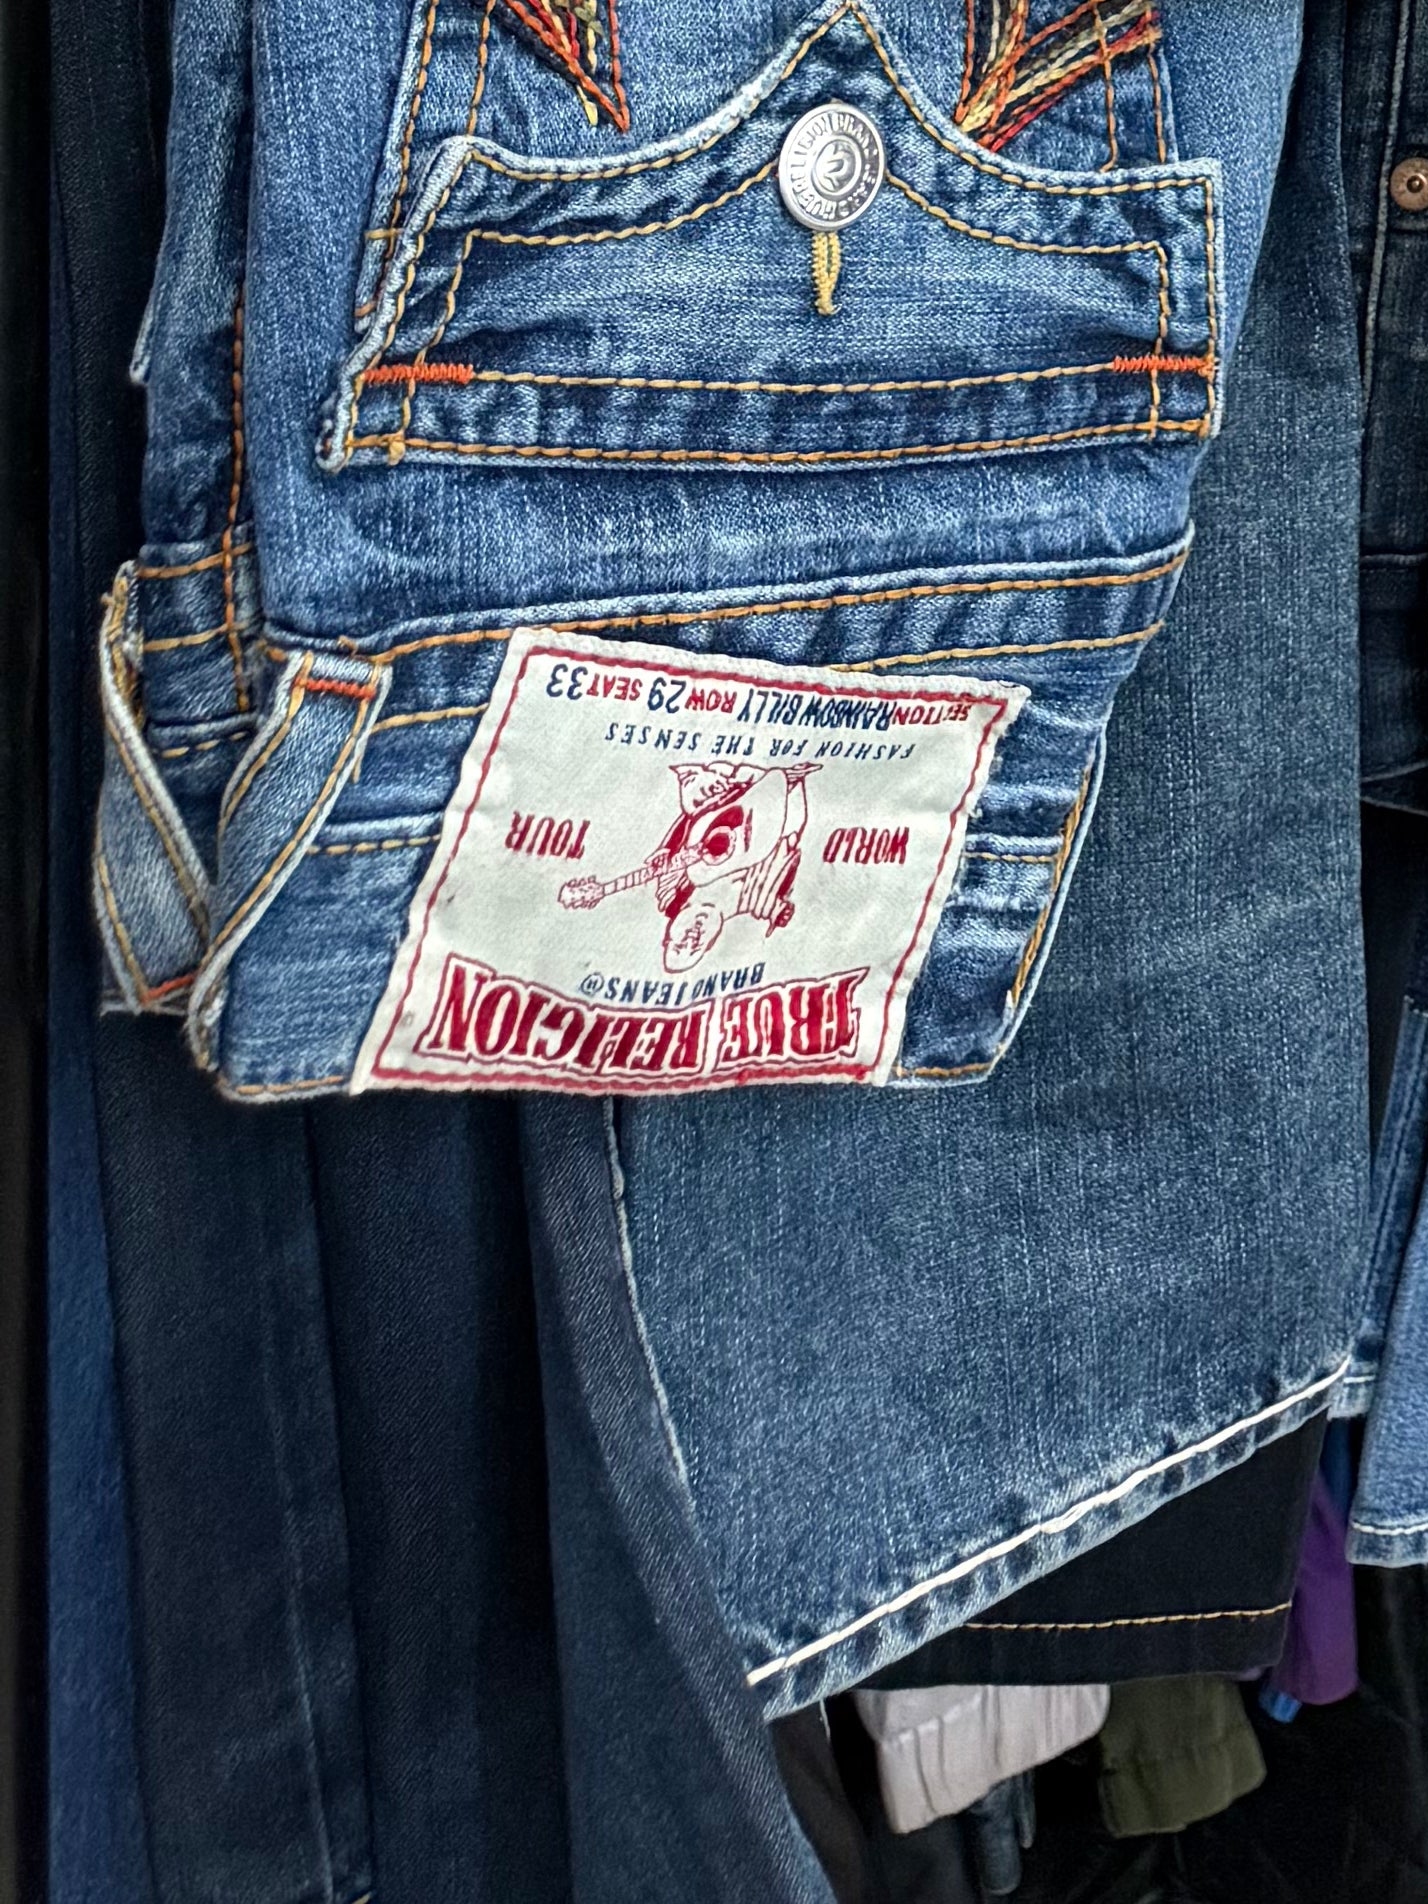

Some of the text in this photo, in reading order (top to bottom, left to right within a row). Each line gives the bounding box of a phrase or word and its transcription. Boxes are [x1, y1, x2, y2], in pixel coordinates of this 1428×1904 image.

[545, 662, 972, 731] SECTION RAINBOW BILLY ROW 29 SEAT 33
[604, 721, 914, 761] FASHION FOR THE SENSES
[504, 810, 590, 859] TOUR
[821, 825, 910, 865] WORLD
[691, 956, 765, 1001] BRAND
[416, 956, 861, 1076] TRUE RELIGION
